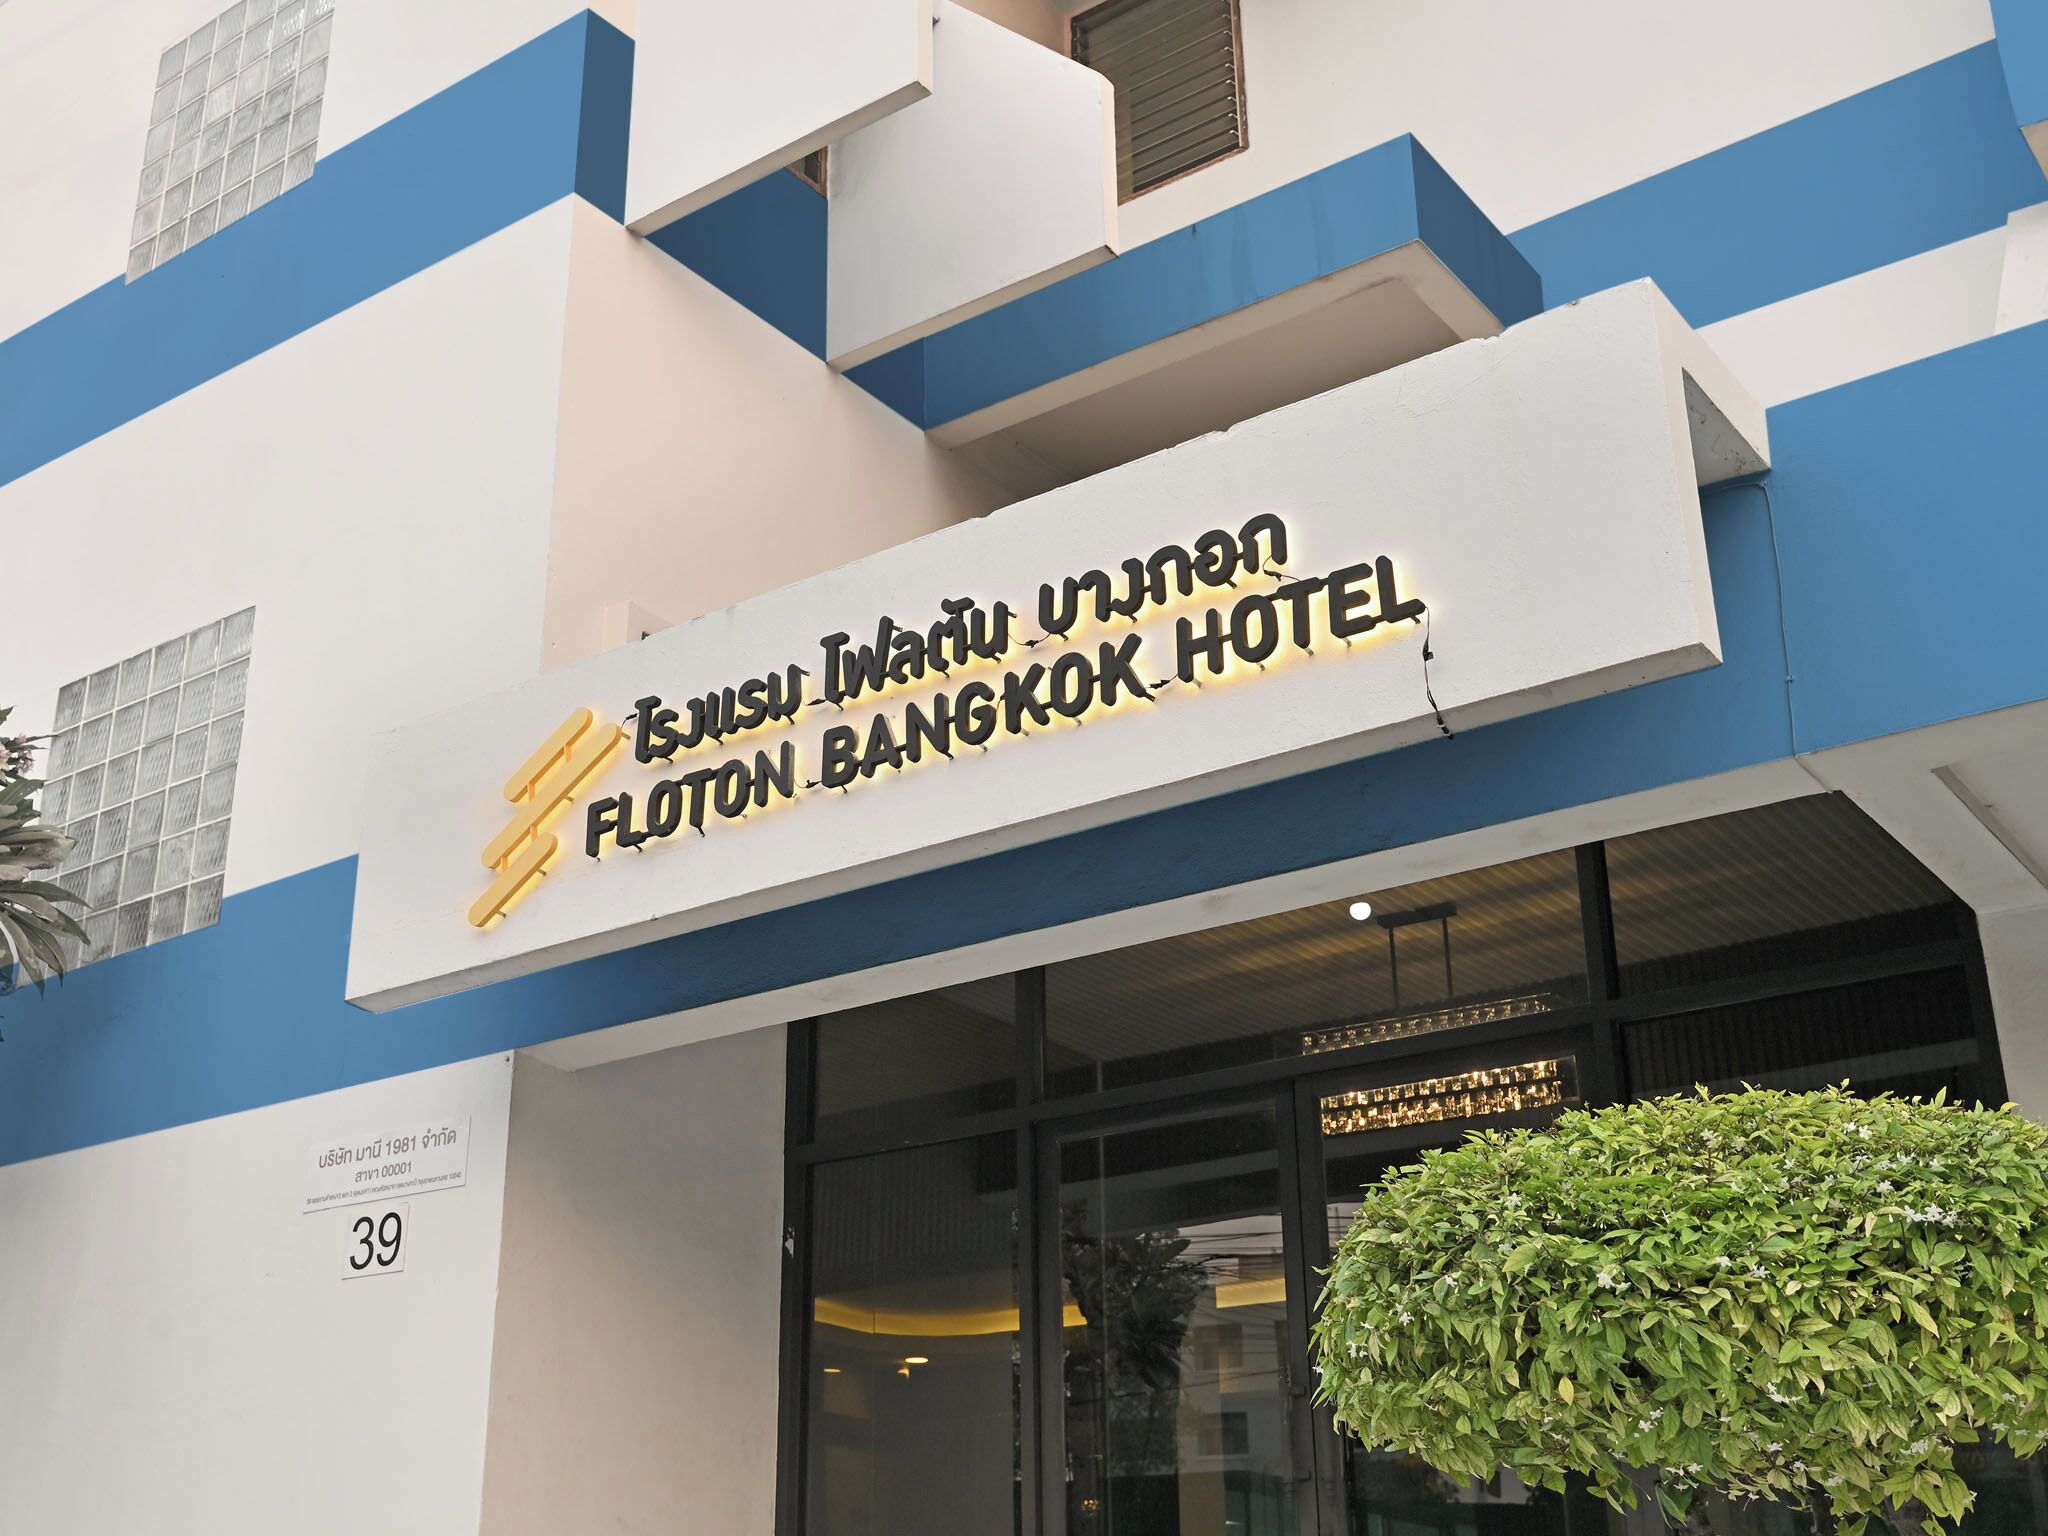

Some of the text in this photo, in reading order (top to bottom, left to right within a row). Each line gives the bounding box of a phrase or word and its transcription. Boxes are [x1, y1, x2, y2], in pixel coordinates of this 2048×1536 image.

[634, 513, 1287, 764] โรงแรม โฟลตัน บางกอก
[587, 555, 1425, 857] FLOTON BANGKOK HOTEL
[319, 1148, 353, 1168] บริษัท
[385, 1135, 417, 1157] 1981
[422, 1127, 456, 1149] จำกัด
[355, 1160, 413, 1183] สาขา 00001
[349, 1211, 402, 1270] 39
